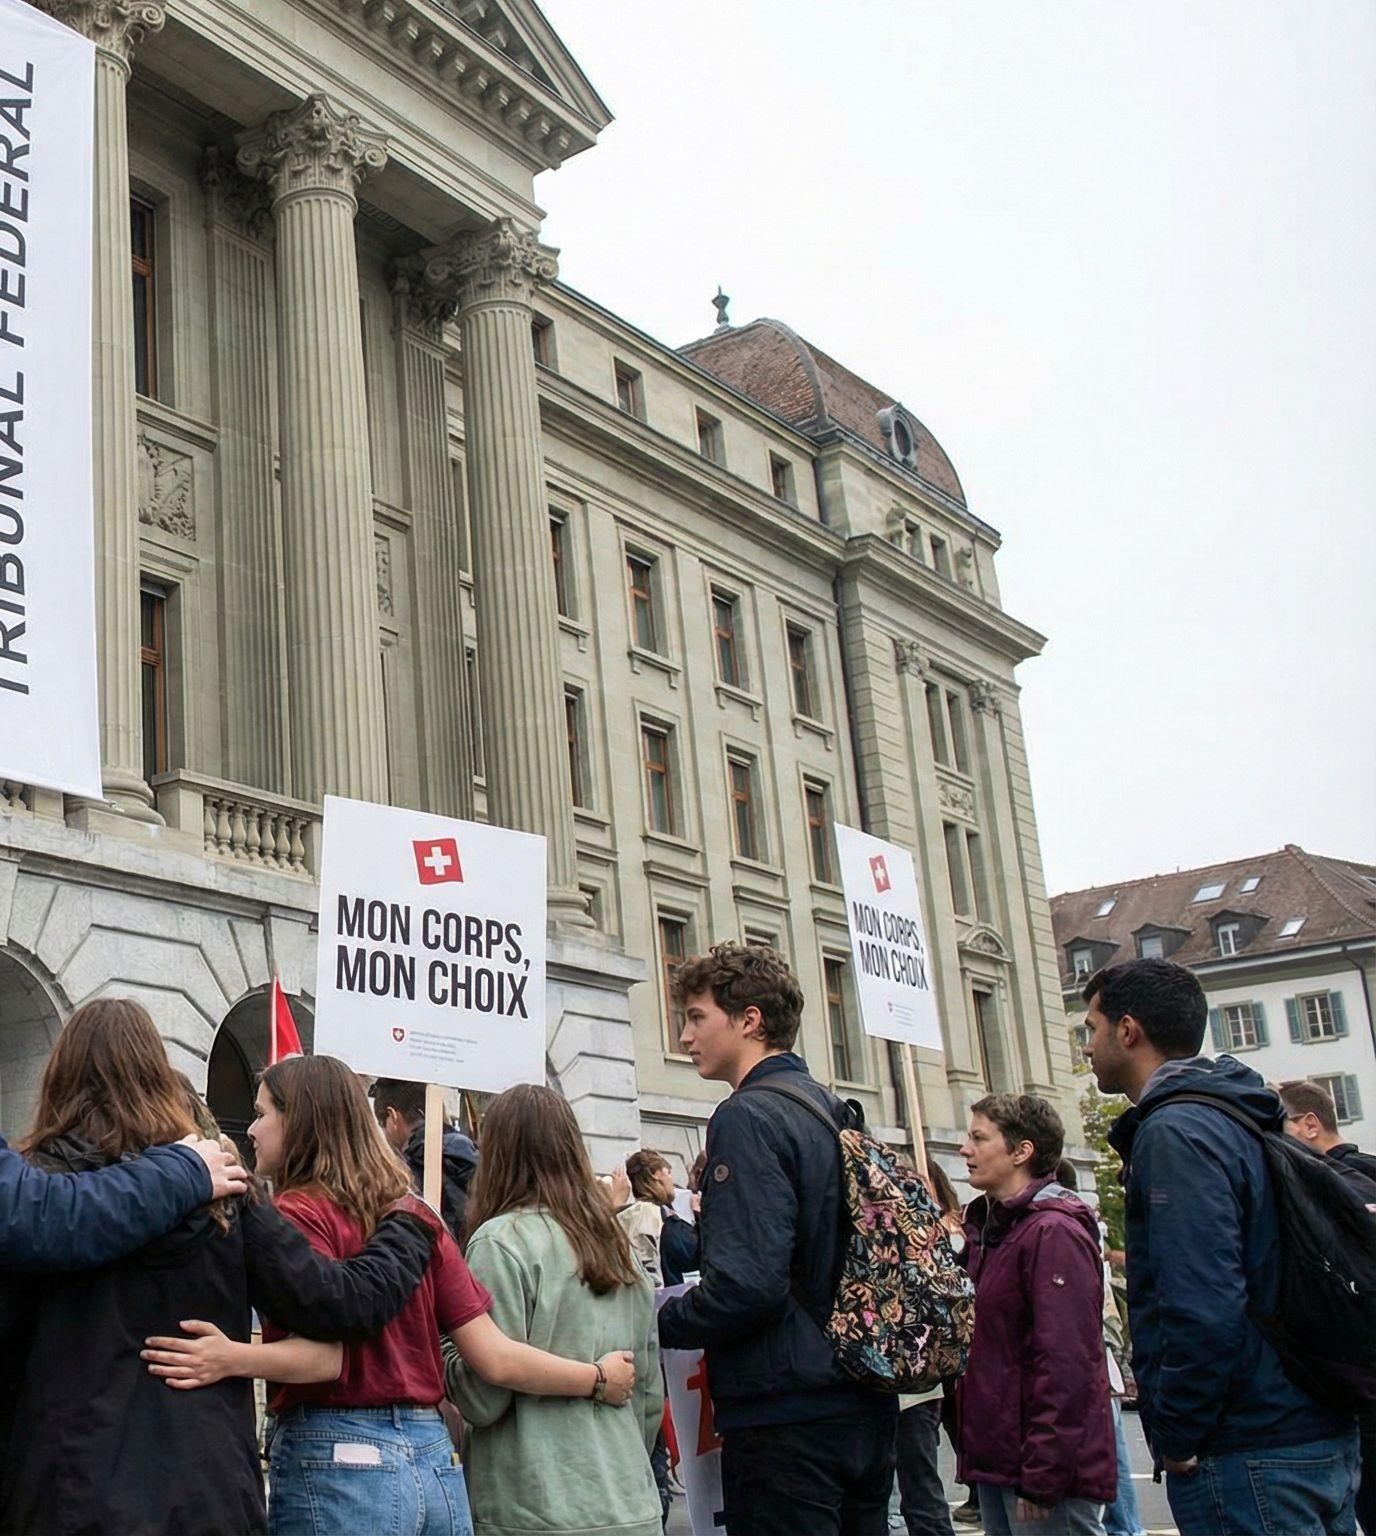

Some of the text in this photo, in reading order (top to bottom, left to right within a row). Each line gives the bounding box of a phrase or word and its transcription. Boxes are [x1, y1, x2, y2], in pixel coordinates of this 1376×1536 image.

[337, 894, 531, 972] MON CORPS,
[852, 901, 883, 940] MON
[336, 944, 529, 1019] MON CHOIX
[859, 940, 929, 991] MON CHOIX
